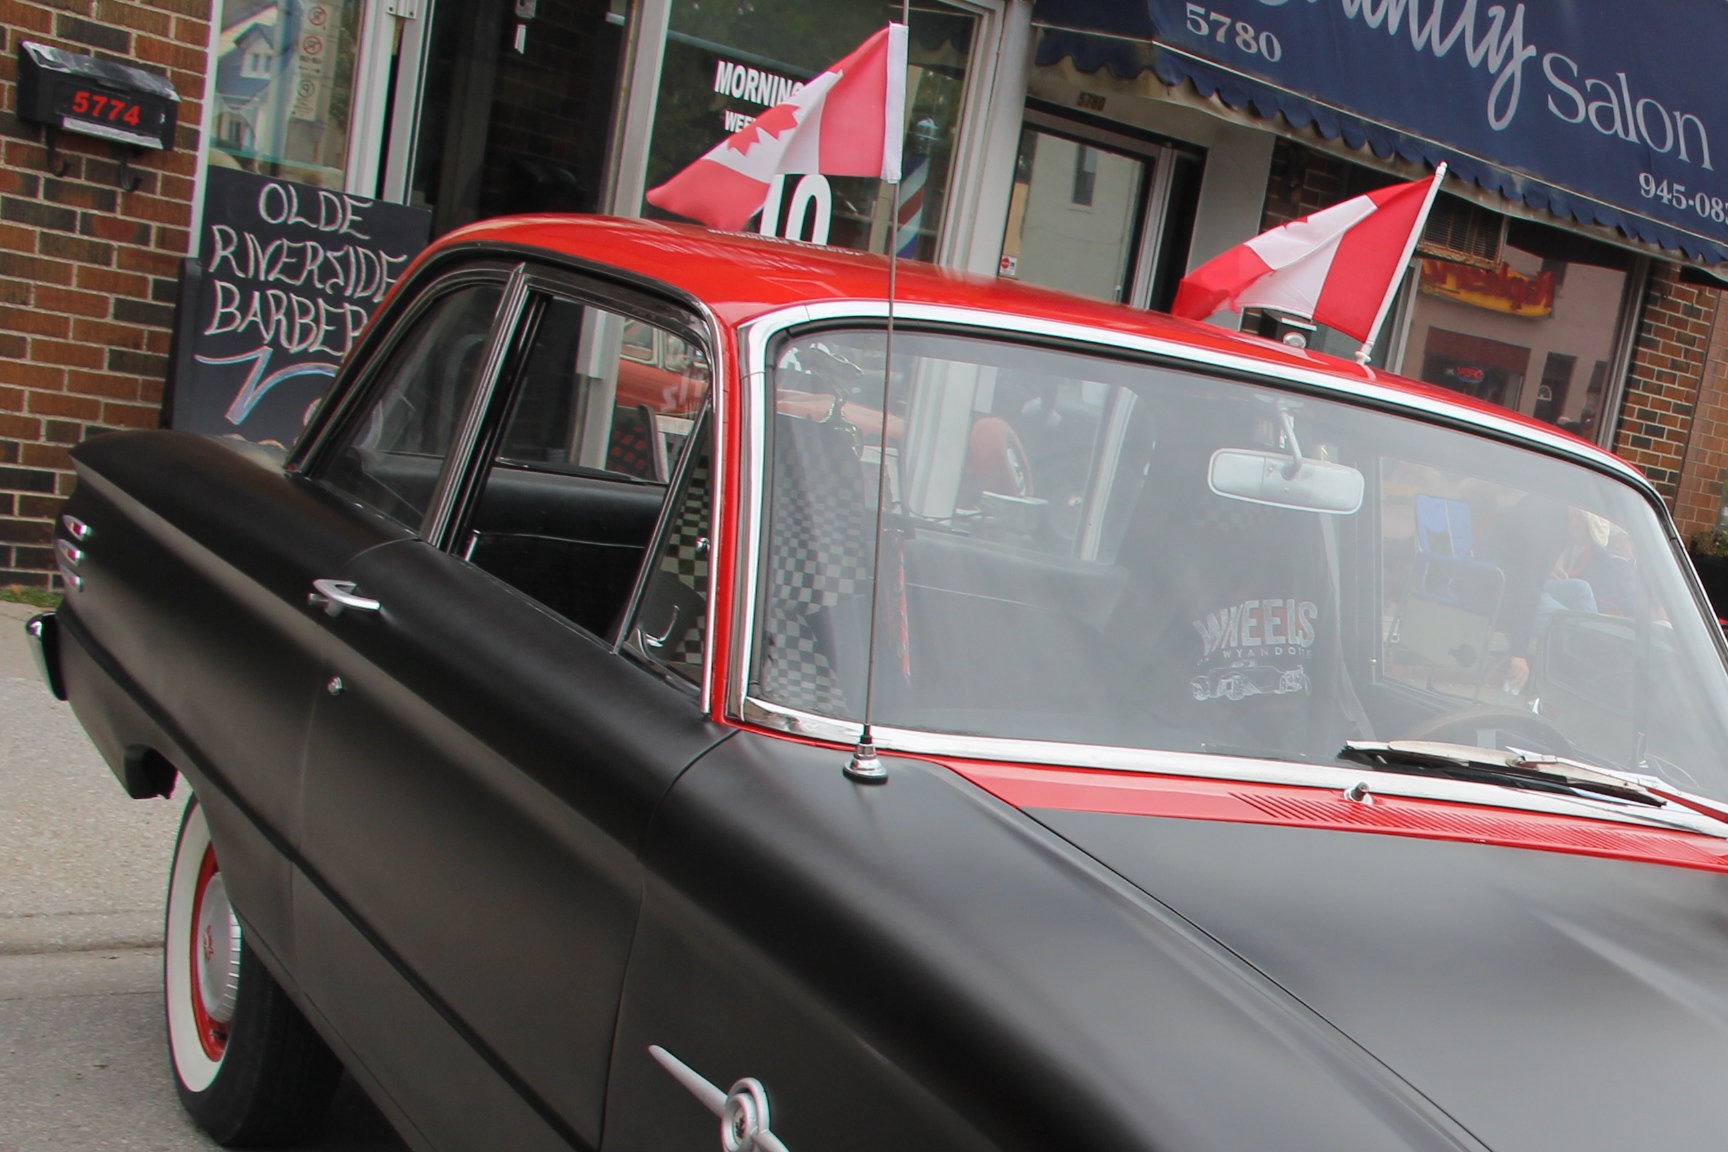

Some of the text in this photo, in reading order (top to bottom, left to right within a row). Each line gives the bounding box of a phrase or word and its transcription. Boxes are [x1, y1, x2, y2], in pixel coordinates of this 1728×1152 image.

[1186, 2, 1283, 63] 5780
[72, 91, 142, 126] 5774
[1542, 52, 1714, 171] Salon
[258, 182, 374, 240] OLDE
[208, 225, 408, 303] RIVERSIDE
[1192, 598, 1319, 656] WHEELS
